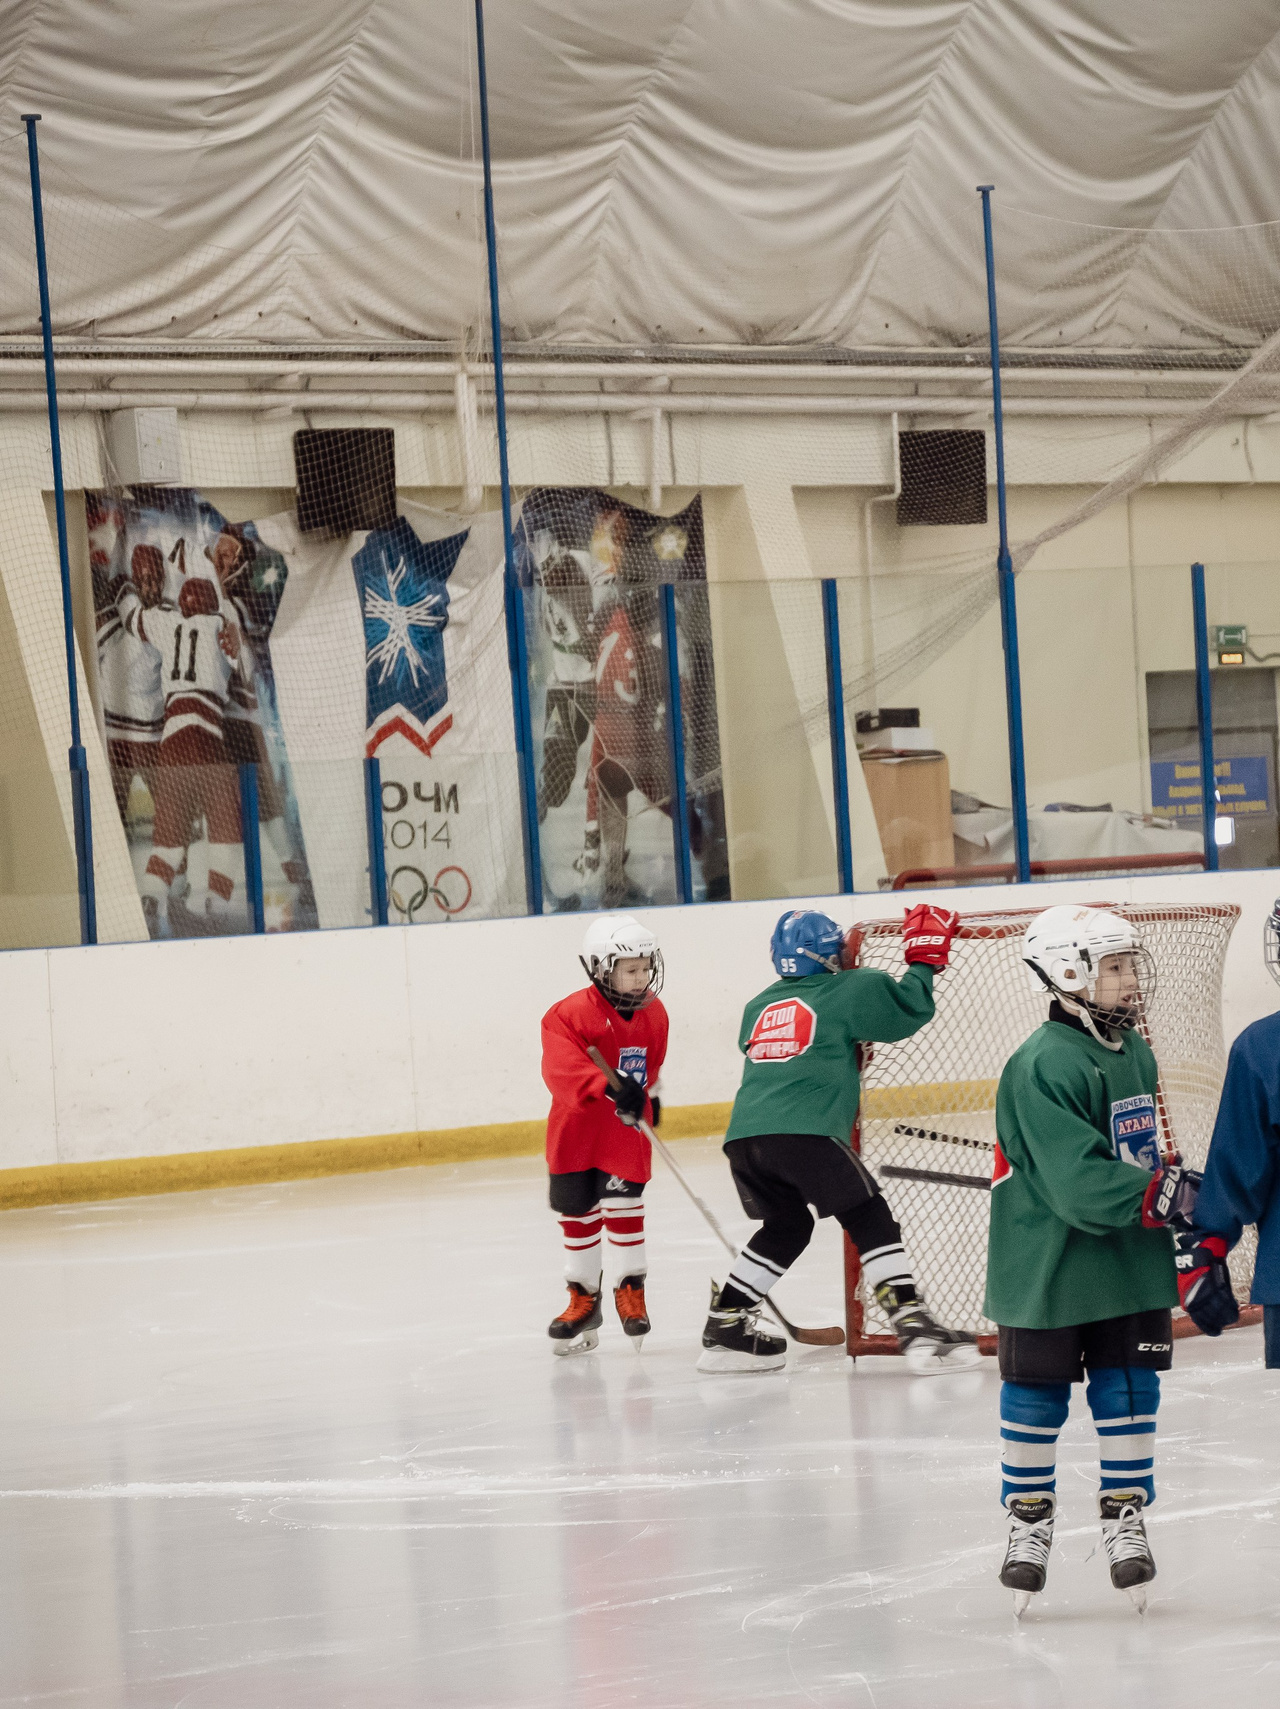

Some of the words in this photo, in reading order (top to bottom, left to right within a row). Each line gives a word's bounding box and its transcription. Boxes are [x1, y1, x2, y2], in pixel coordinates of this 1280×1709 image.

[171, 623, 199, 682] 11
[381, 781, 459, 814] ОЧИ
[383, 820, 452, 849] 014
[780, 958, 797, 973] 95
[761, 1004, 797, 1030] СТОП
[1137, 1342, 1171, 1352] CCM
[1015, 1503, 1048, 1511] BAUER
